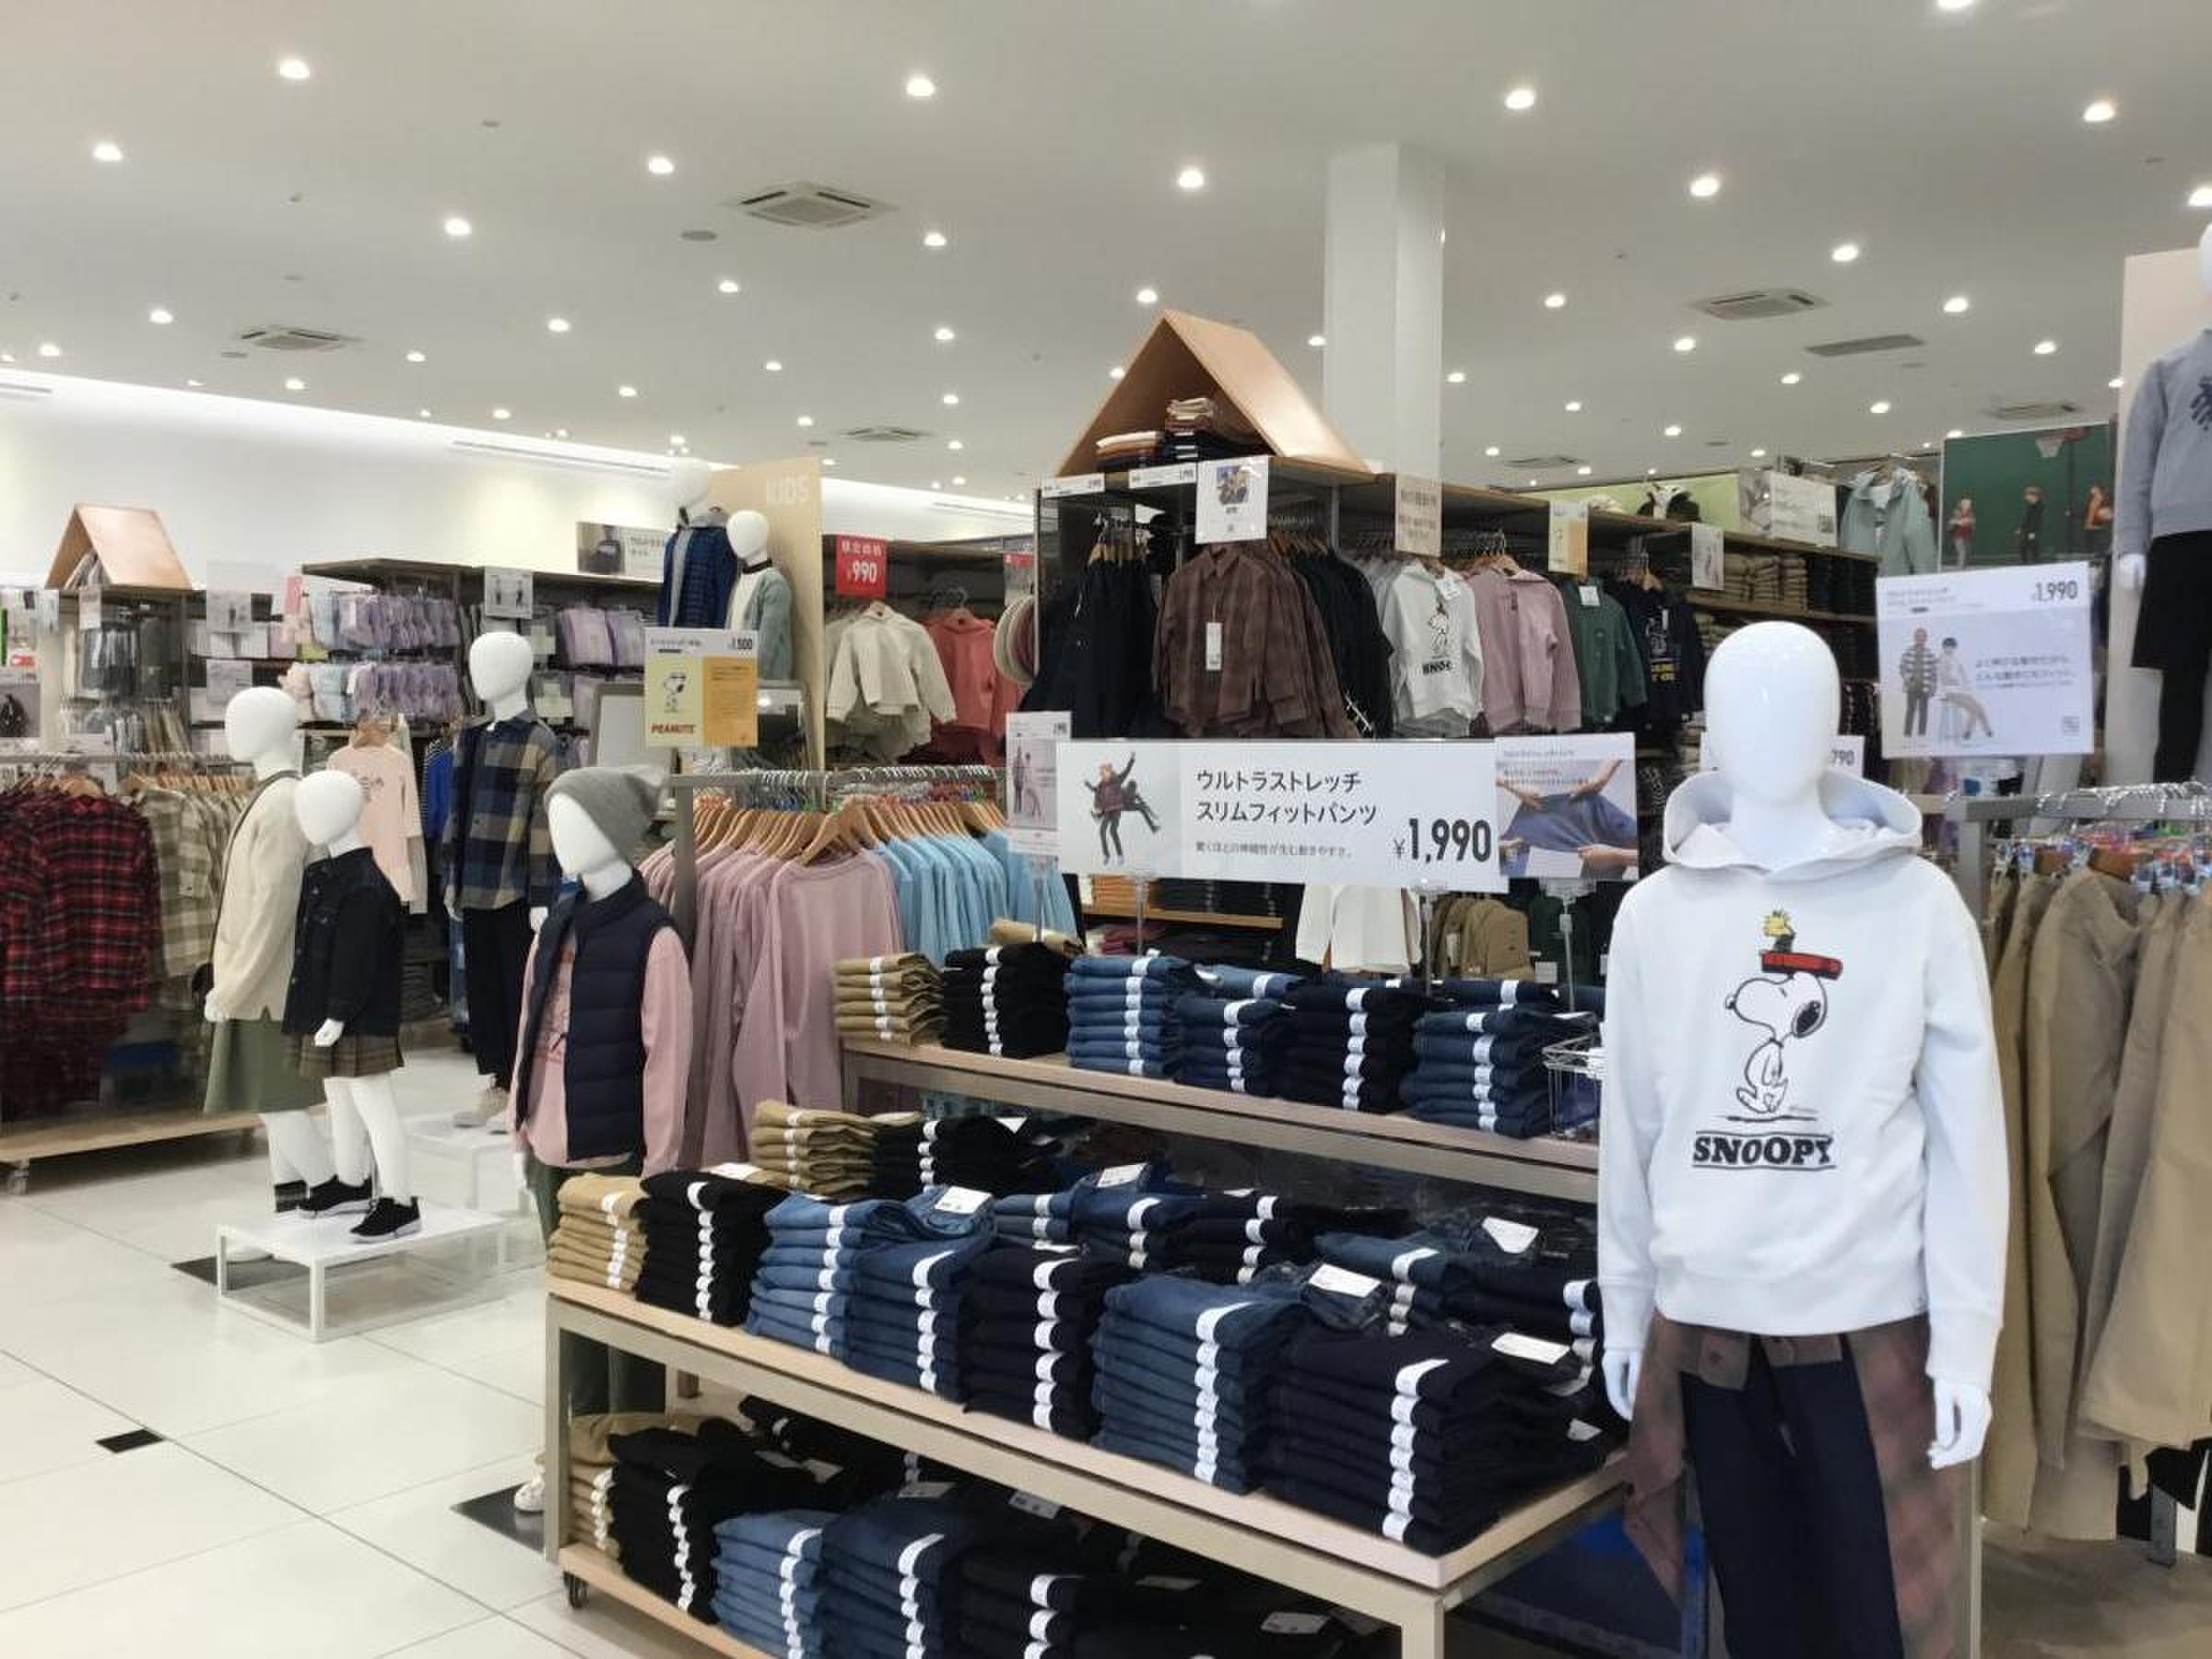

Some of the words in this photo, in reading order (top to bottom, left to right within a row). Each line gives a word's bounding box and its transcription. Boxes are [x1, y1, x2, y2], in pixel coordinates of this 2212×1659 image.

[1196, 771, 1362, 793] ウルトラストレッチ
[1196, 801, 1377, 825] スリムフィットパンツ
[1693, 1136, 1833, 1165] SNOOPY
